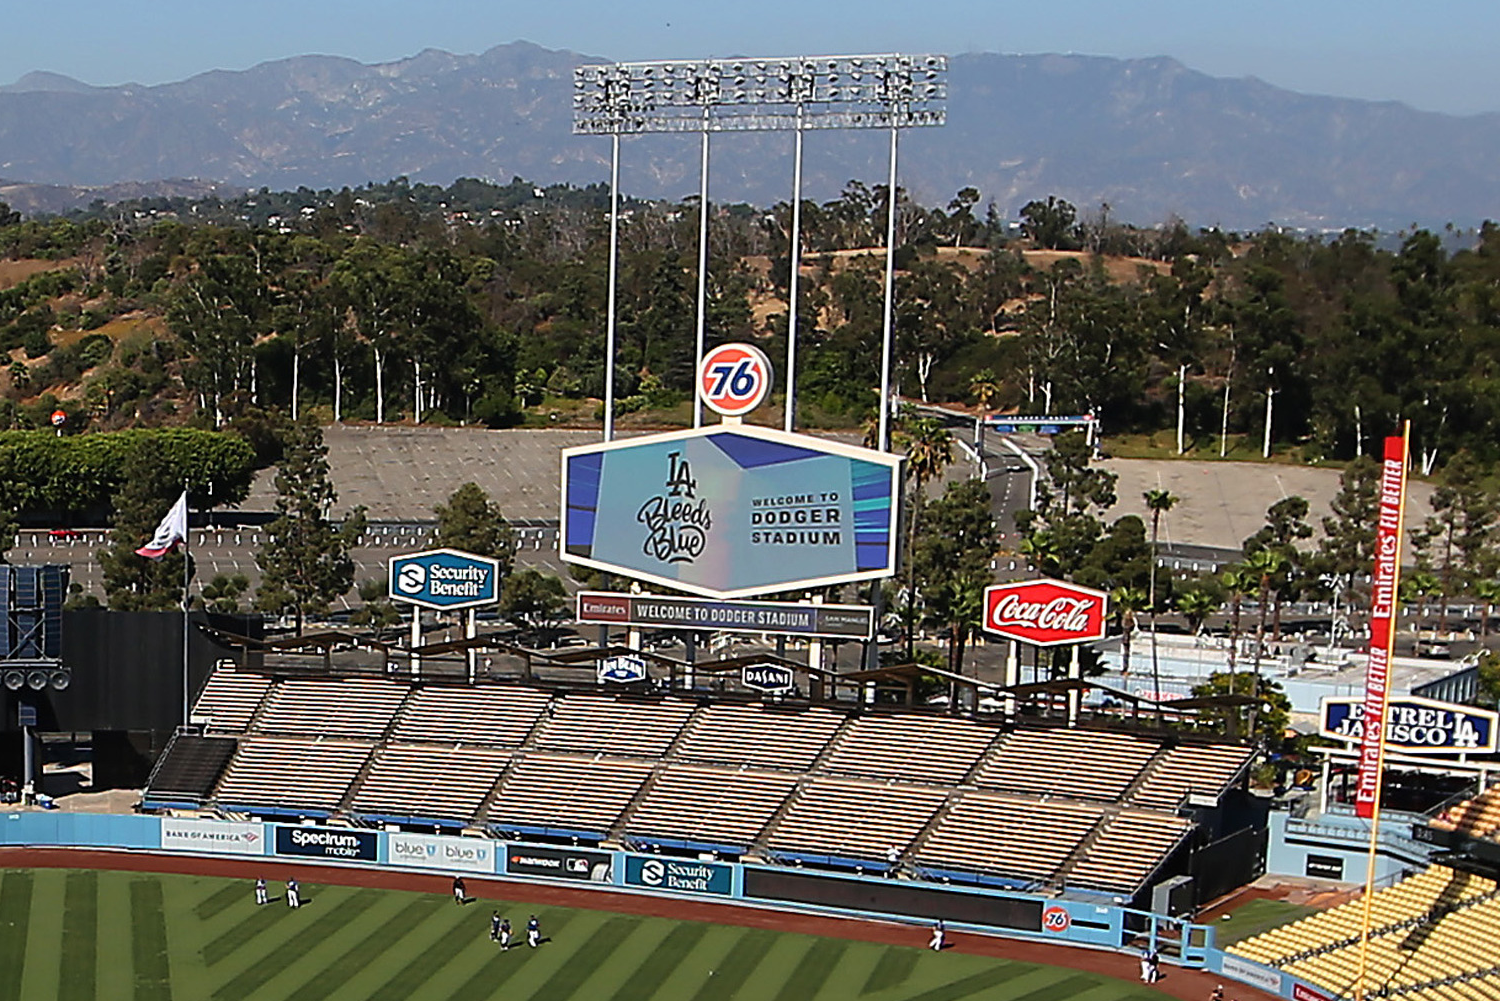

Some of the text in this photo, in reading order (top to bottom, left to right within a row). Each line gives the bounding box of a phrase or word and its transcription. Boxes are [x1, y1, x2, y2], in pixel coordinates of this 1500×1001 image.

[706, 357, 761, 401] 76
[666, 452, 696, 499] LA
[752, 493, 839, 507] WELCOME TO
[637, 497, 712, 531] Bleeds
[752, 508, 840, 525] DODGER
[644, 525, 706, 561] Blue
[752, 531, 841, 545] STADIUM
[1372, 459, 1402, 617] Emirates FLY BETTER
[430, 564, 489, 584] Security
[430, 580, 478, 596] Benefit
[583, 602, 626, 614] Emirates
[637, 604, 809, 627] WELCOME TO DODGER STADIUM
[993, 594, 1095, 632] Coca-Cola
[746, 670, 789, 684] DASANI
[1349, 703, 1453, 729] ETREL
[1357, 646, 1387, 802] Emirates FLY BETTER
[1335, 719, 1447, 745] JAISCO
[202, 833, 240, 841] AMERICA
[292, 830, 357, 850] Spectrum
[395, 842, 424, 855] blue
[444, 845, 474, 858] blue
[667, 862, 715, 879] Security
[668, 875, 708, 890] Benefit
[1046, 912, 1066, 928] 76
